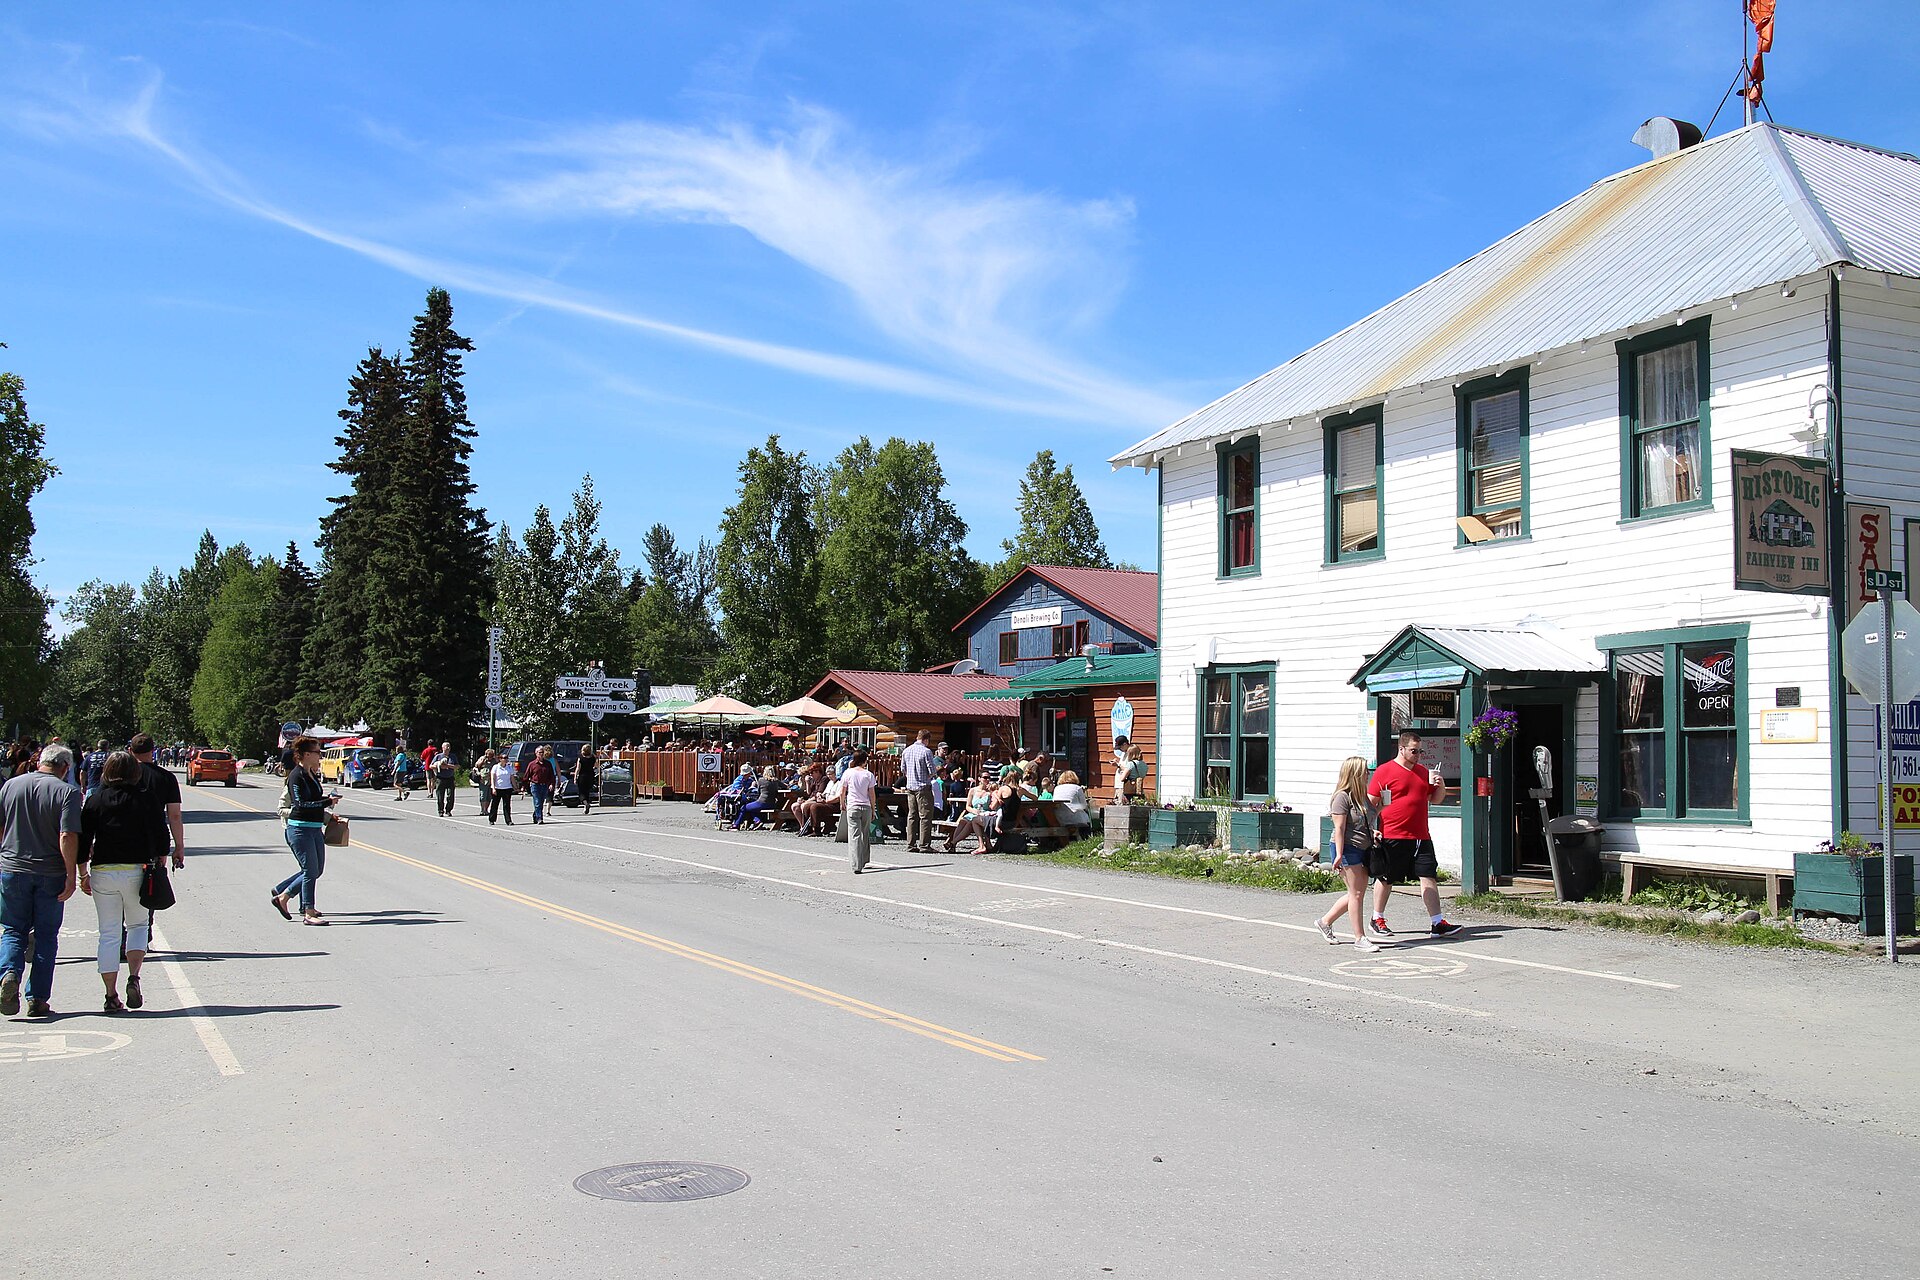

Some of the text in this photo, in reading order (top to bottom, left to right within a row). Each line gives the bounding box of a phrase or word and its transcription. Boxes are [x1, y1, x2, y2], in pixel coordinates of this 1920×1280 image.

[1741, 469, 1820, 508] HISTORIC
[1746, 551, 1820, 571] FAIRVIEW INN
[1858, 514, 1880, 602] SAL
[1867, 571, 1902, 588] S D ST
[1013, 614, 1029, 624] Denali
[1030, 613, 1051, 623] Brewing
[564, 679, 629, 689] Twister Creek
[1416, 691, 1452, 701] TONIGHTS
[1698, 696, 1729, 710] OPEN
[561, 701, 630, 711] Denali Brewing Co.
[1891, 704, 1920, 730] HILL
[1892, 787, 1920, 804] FO
[1881, 807, 1920, 824] AL
